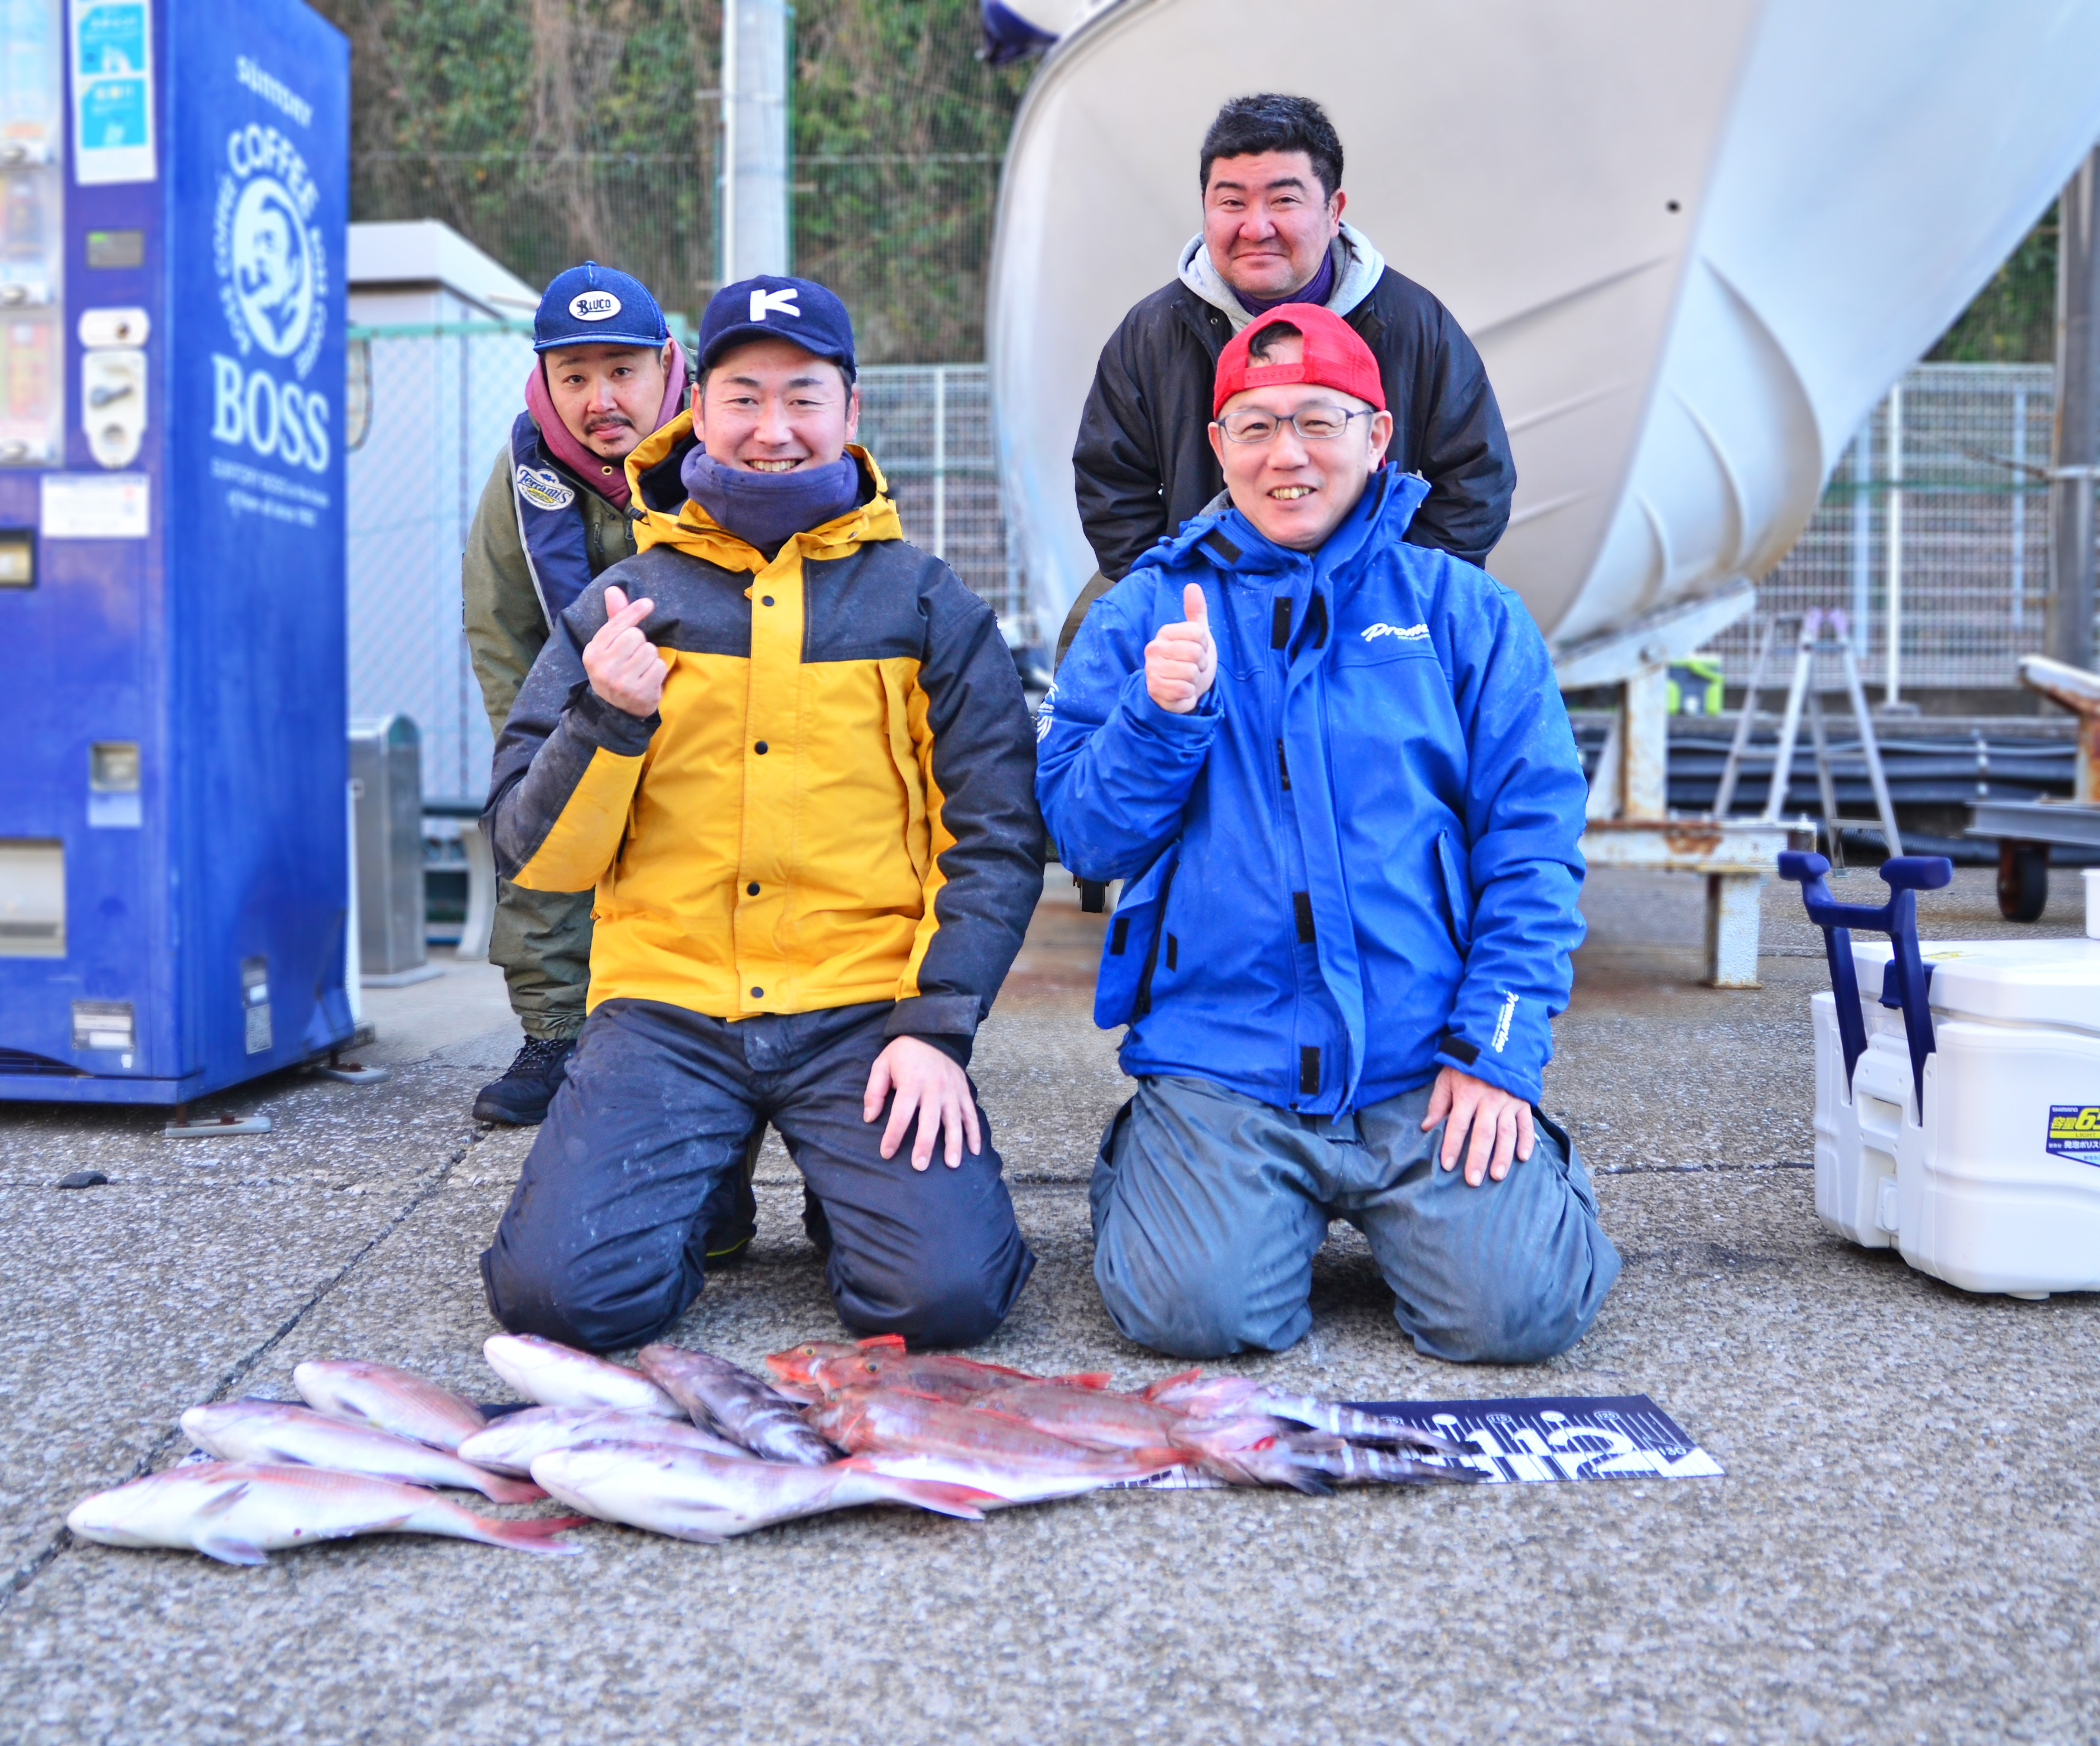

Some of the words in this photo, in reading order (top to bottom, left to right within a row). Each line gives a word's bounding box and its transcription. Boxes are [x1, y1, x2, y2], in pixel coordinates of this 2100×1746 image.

[749, 288, 801, 321] K
[212, 354, 330, 474] BOSS
[2064, 1141, 2100, 1149] 発泡ポリス
